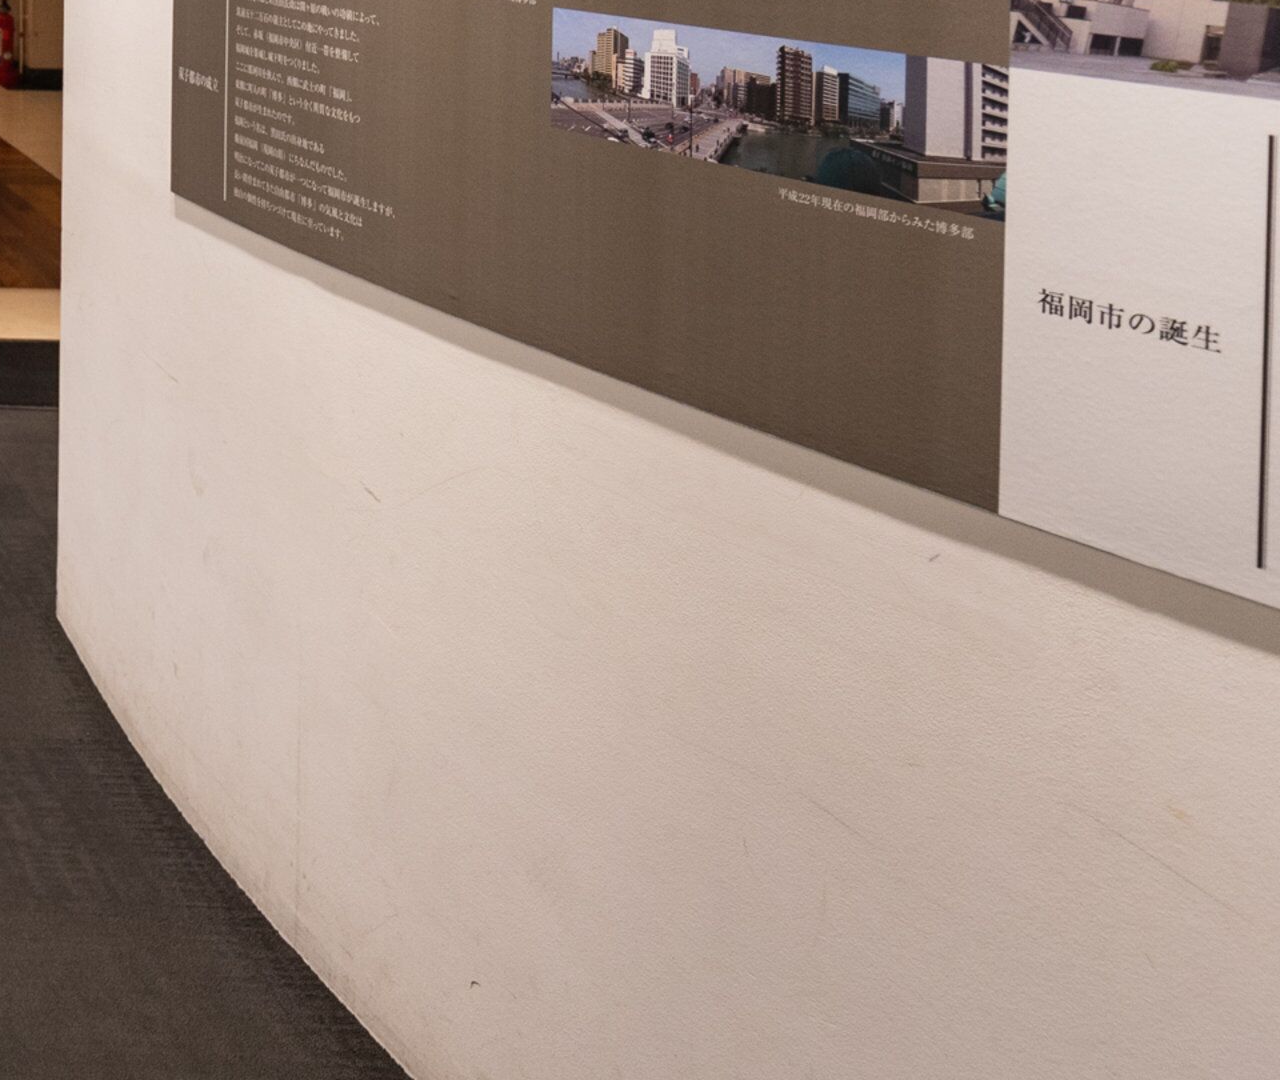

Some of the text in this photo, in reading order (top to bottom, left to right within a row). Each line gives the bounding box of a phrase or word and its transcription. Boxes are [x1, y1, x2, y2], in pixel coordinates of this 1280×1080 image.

[1037, 286, 1223, 355] 福岡市の誕生
